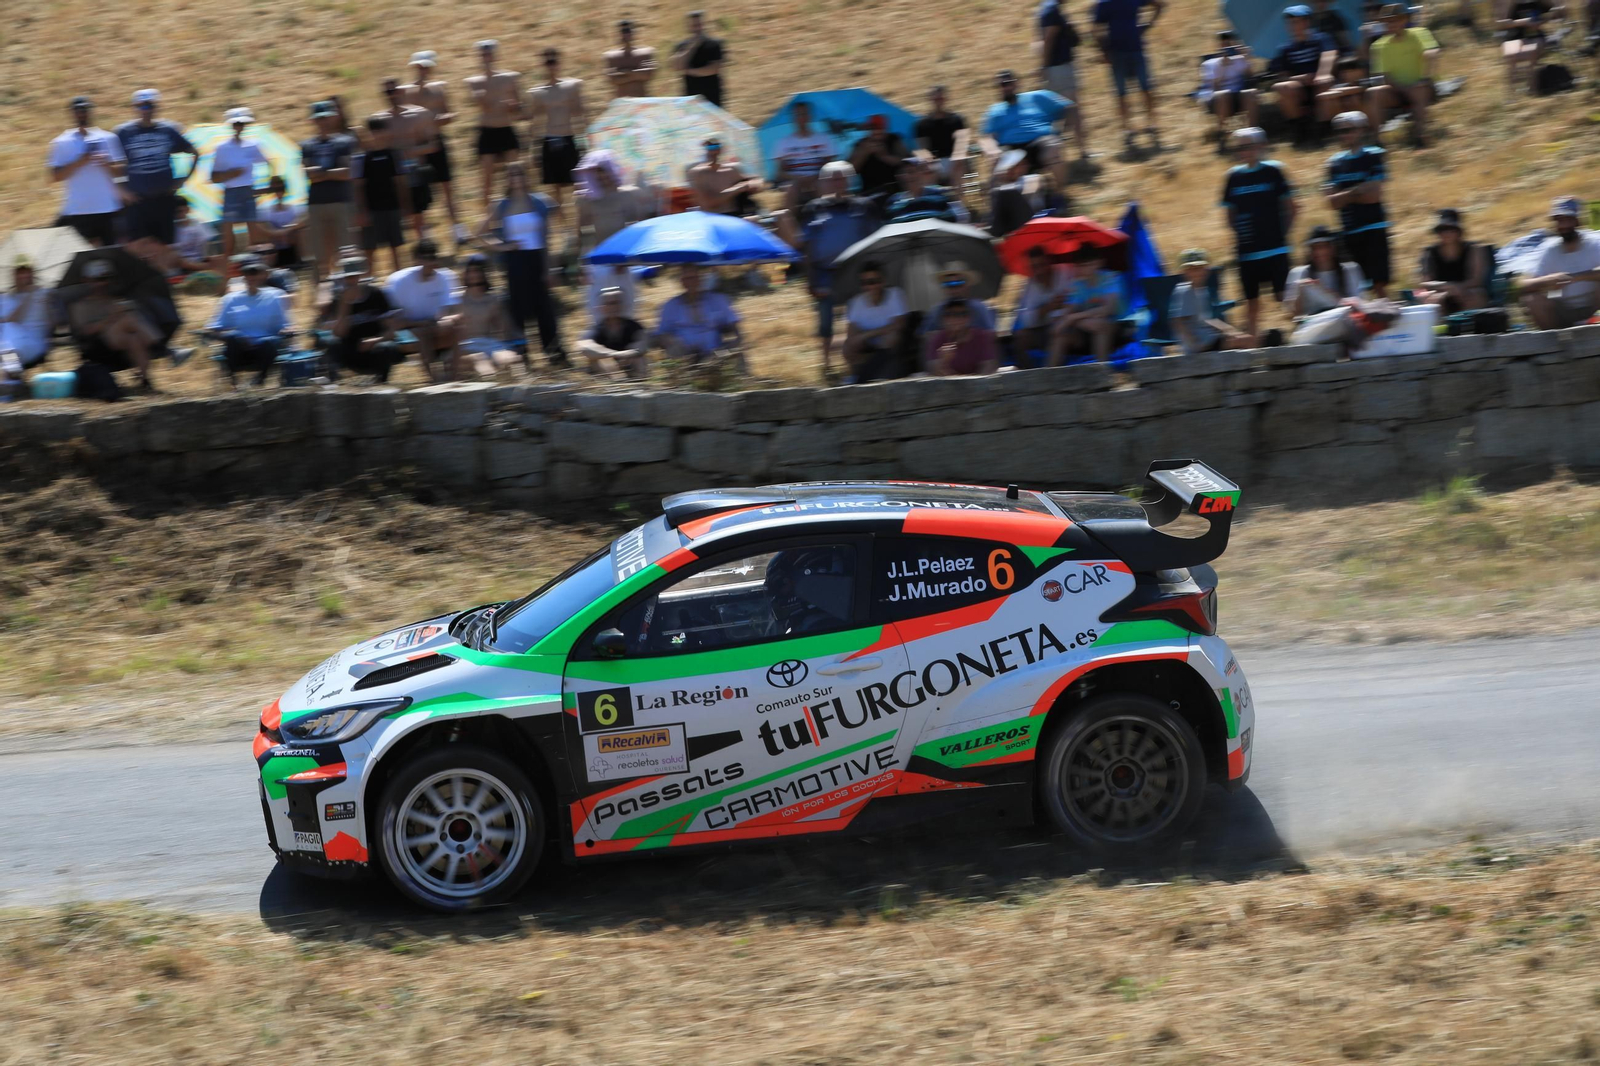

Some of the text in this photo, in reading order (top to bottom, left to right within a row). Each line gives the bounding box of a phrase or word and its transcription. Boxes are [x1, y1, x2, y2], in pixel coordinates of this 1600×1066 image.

[887, 557, 975, 579] J.L.Pelaez
[987, 549, 1015, 590] 6
[1064, 564, 1111, 594] CAR
[888, 575, 987, 602] J.Murado
[594, 693, 618, 726] 6
[635, 685, 749, 711] La Región
[756, 686, 833, 714] Comauto Sur
[612, 733, 656, 748] Recalvi
[939, 725, 1030, 756] VALLEROS
[1005, 738, 1031, 751] SPORT
[616, 752, 649, 760] HOSPITAL
[617, 754, 685, 770] recoletas salud
[654, 764, 685, 772] OURENSE
[704, 744, 900, 830] CARMOTIVE
[802, 798, 825, 811] POR
[828, 789, 849, 801] LOS
